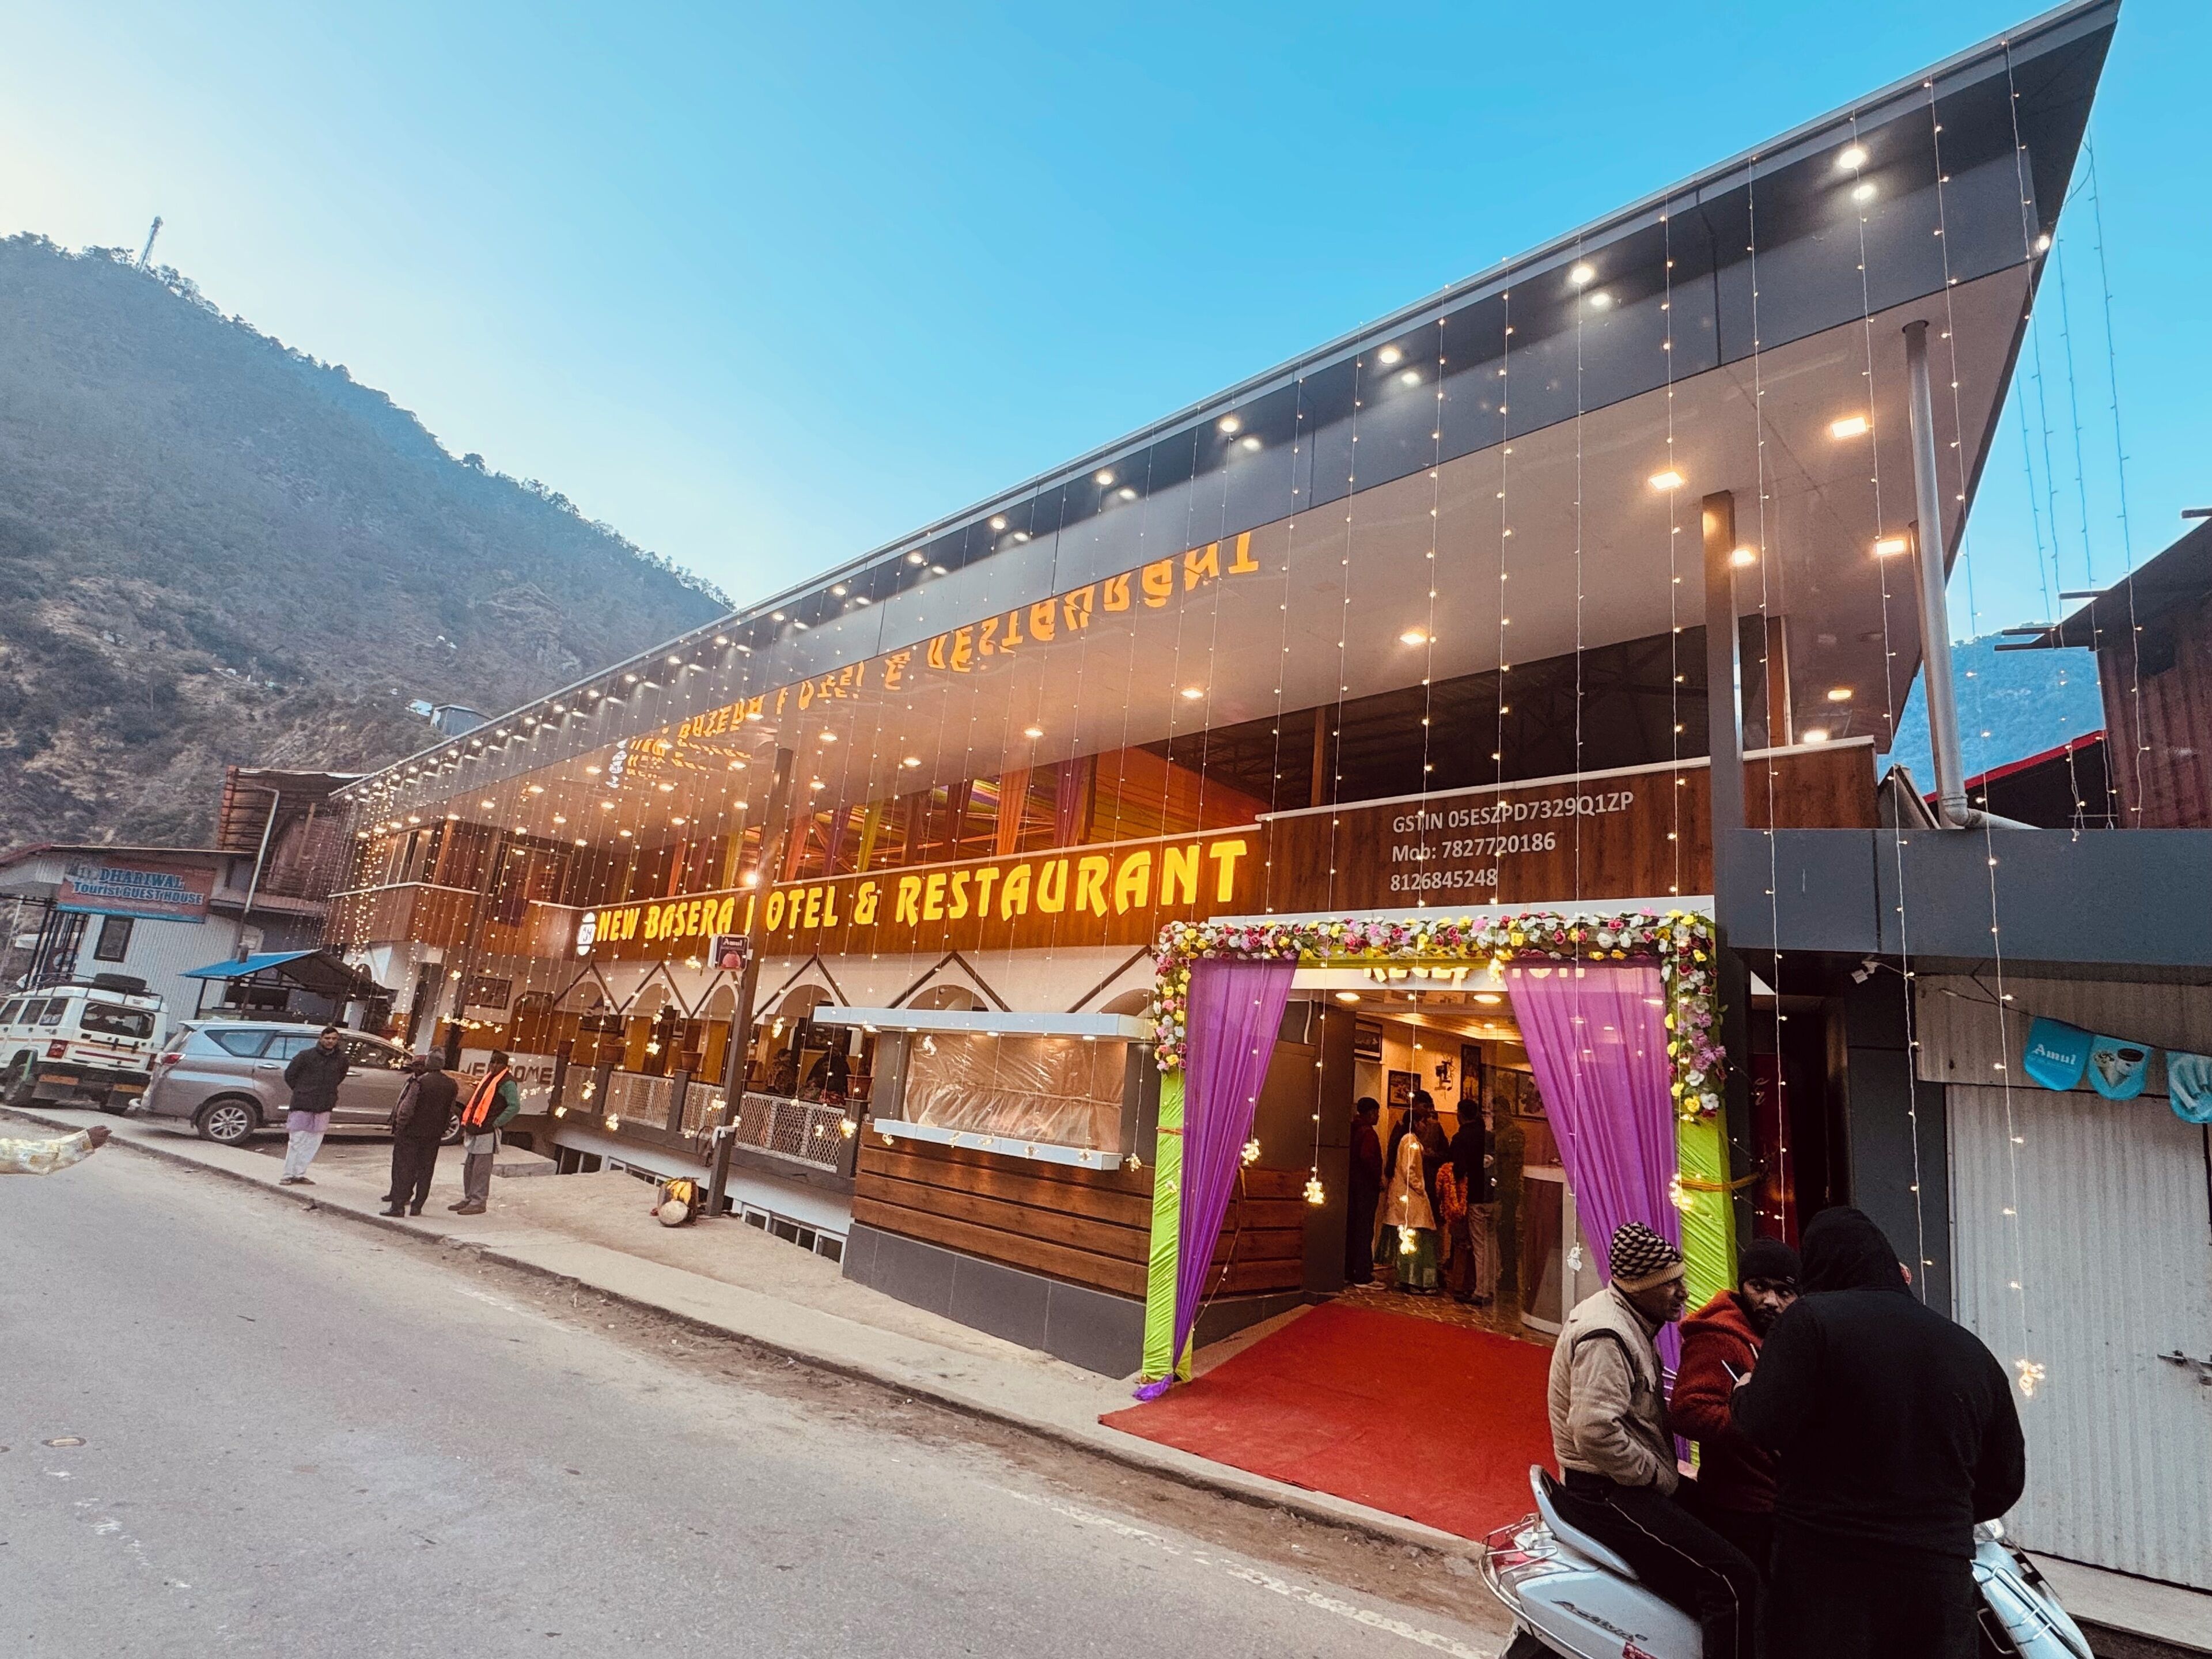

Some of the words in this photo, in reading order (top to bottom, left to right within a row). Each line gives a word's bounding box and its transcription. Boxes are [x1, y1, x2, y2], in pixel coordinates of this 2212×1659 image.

[1392, 812, 1444, 833] GSTIN
[1448, 791, 1634, 829] 05ESZPD7329Q1ZP
[1391, 843, 1437, 862] Mob:
[1441, 831, 1556, 859] 7827720186
[73, 881, 121, 897] Tourist
[99, 868, 185, 890] DHARIWAL
[596, 907, 641, 942] NEW
[643, 896, 736, 941] BASERA
[854, 881, 878, 925] &
[895, 839, 1248, 927] RESTAURANT
[1389, 868, 1498, 892] 8126845248
[2031, 1043, 2077, 1065] Amul
